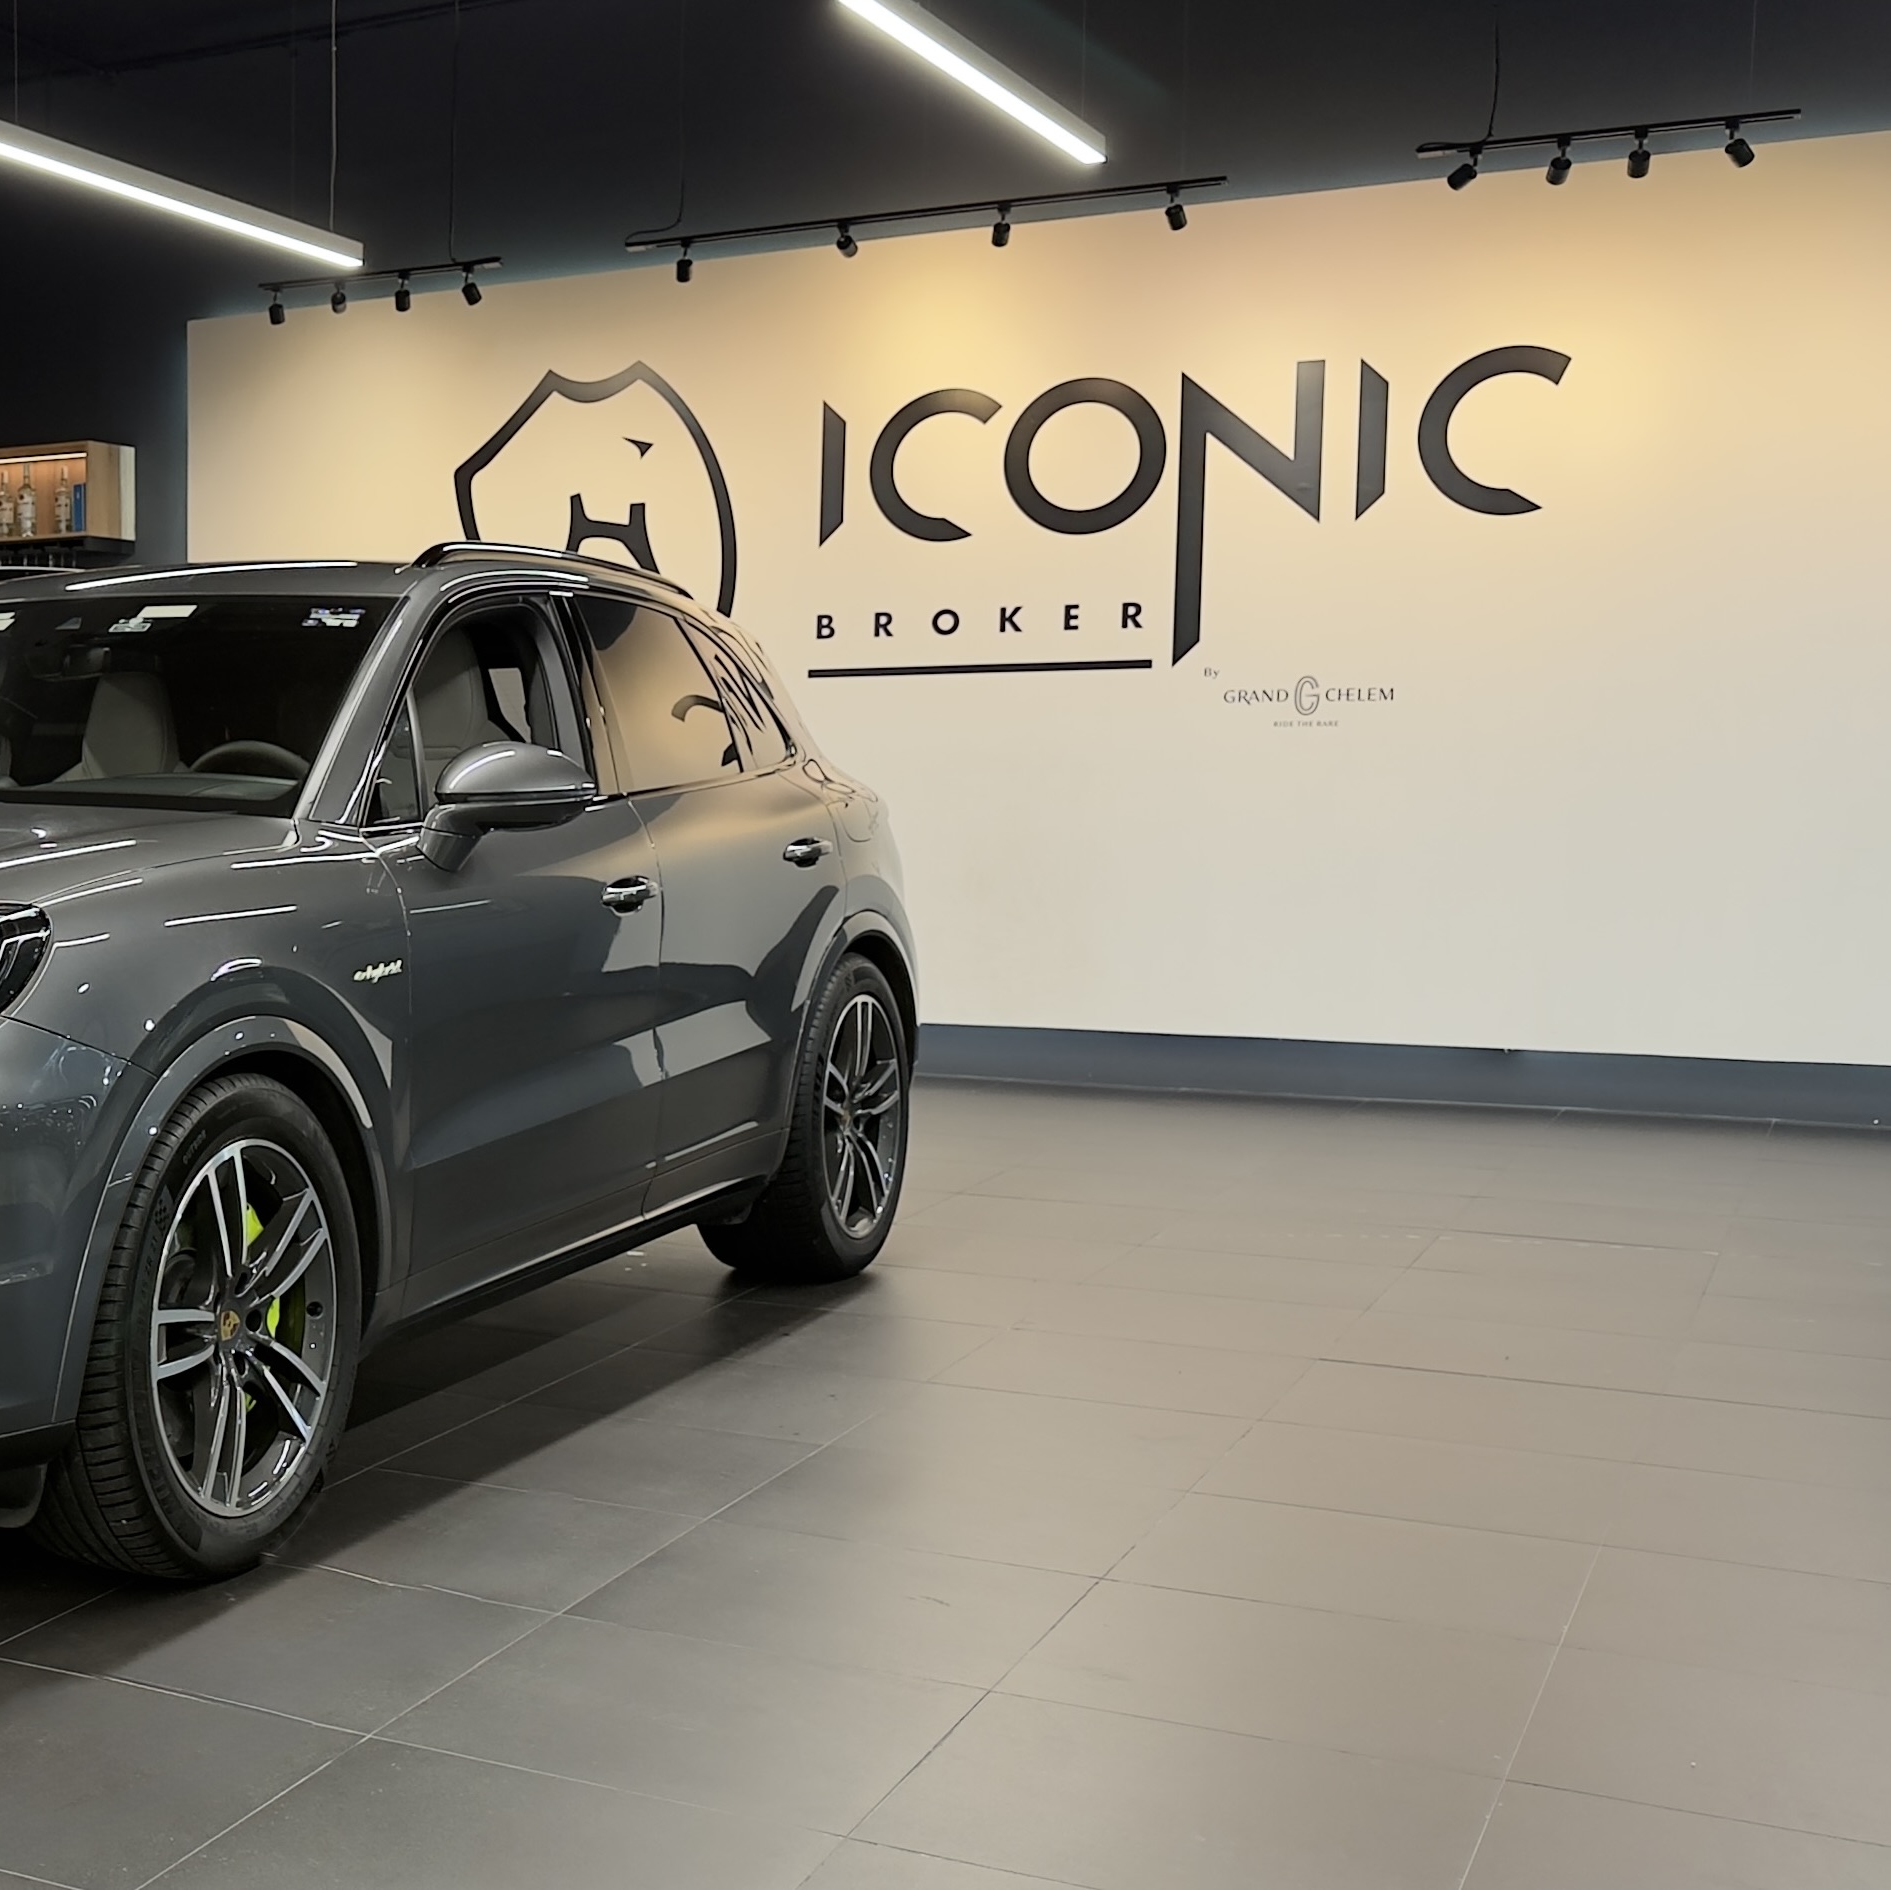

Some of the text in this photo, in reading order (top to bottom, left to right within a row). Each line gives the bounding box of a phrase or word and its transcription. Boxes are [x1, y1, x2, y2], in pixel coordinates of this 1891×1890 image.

[819, 345, 1572, 666] ICONIC
[816, 602, 1143, 640] BROKER
[1203, 667, 1220, 679] By
[1223, 689, 1289, 706] GRAND
[1325, 687, 1395, 702] CHELEM
[1273, 720, 1294, 728] RIDE
[1297, 720, 1314, 728] THE
